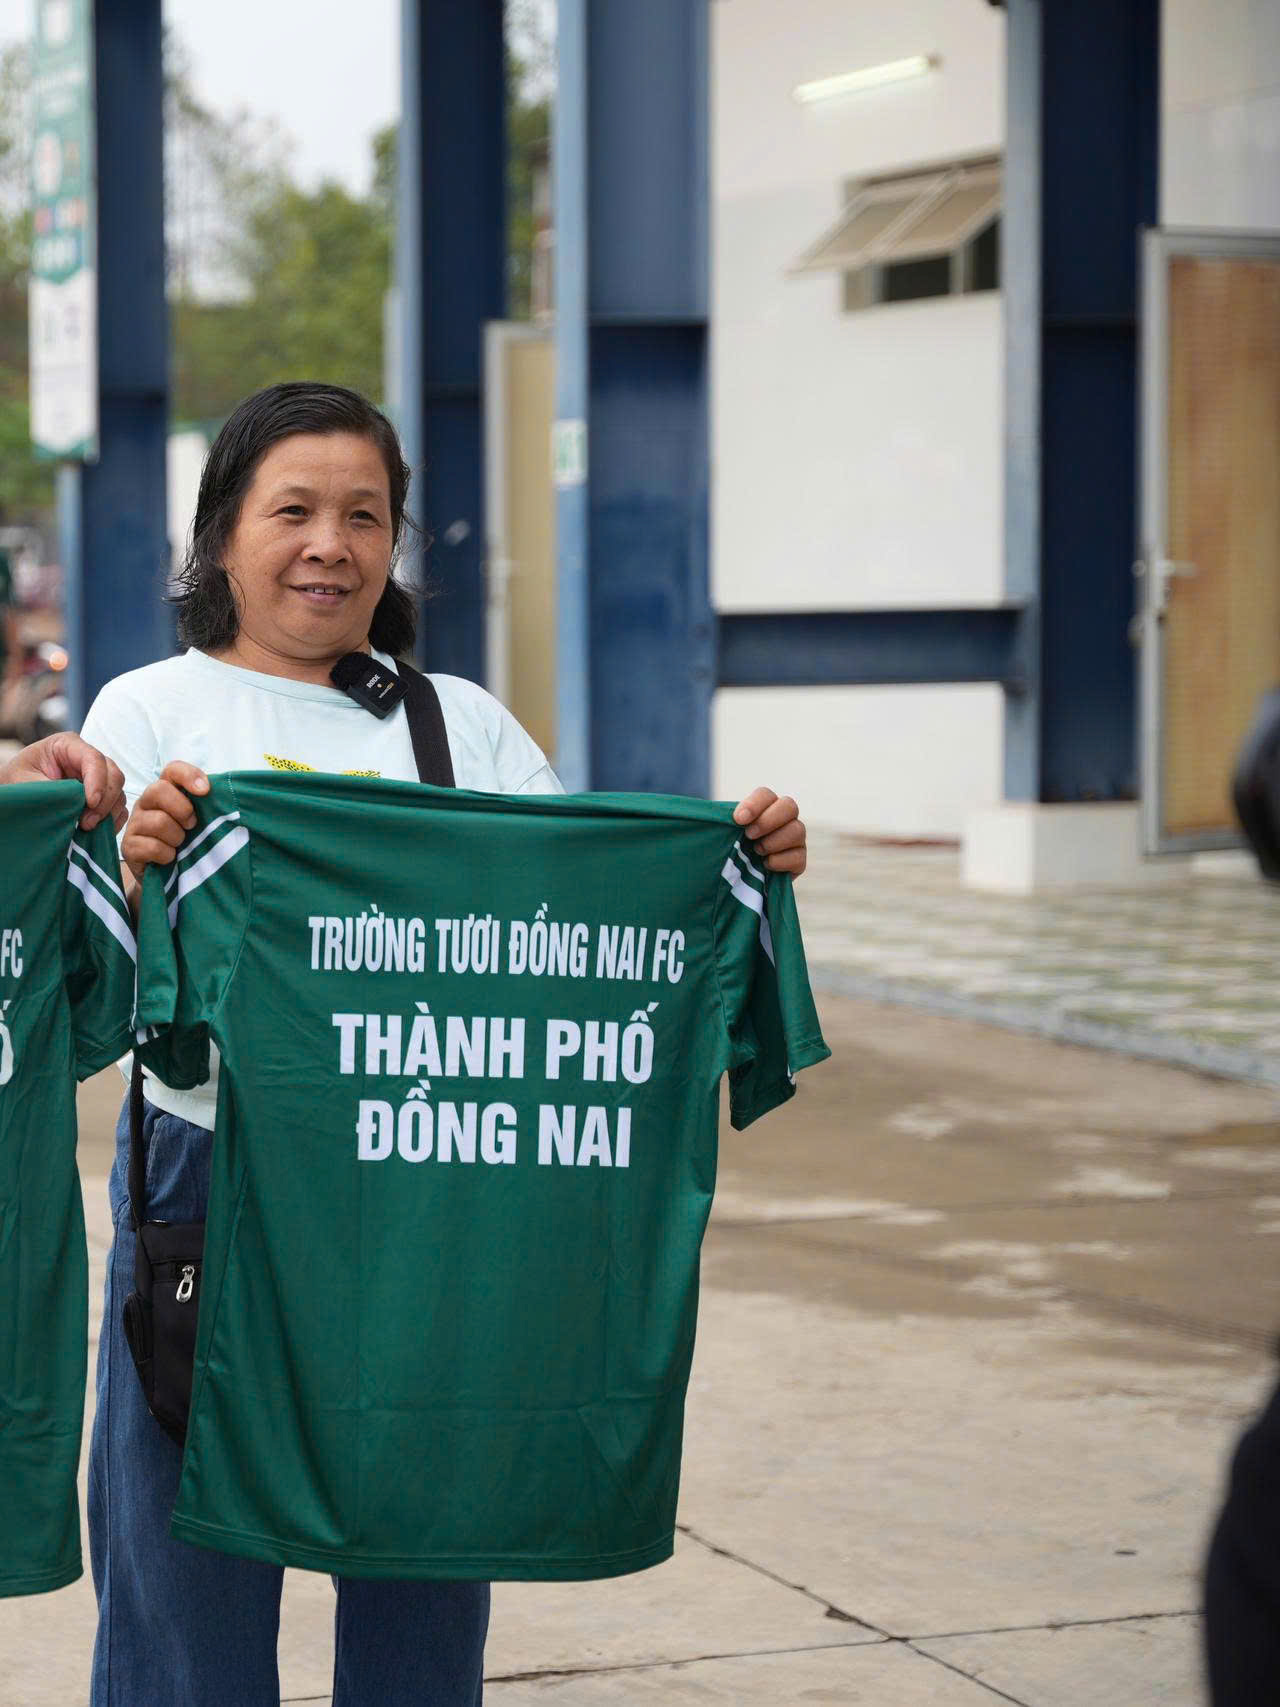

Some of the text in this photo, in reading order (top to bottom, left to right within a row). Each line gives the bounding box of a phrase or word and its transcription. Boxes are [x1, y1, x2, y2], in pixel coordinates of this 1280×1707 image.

[0, 928, 23, 978] FC
[308, 902, 685, 984] TRƯỜNG TƯƠI ĐỒNG NAI FC
[331, 1001, 660, 1084] THÀNH PHỐ
[355, 1079, 632, 1168] ĐỒNG NAI
